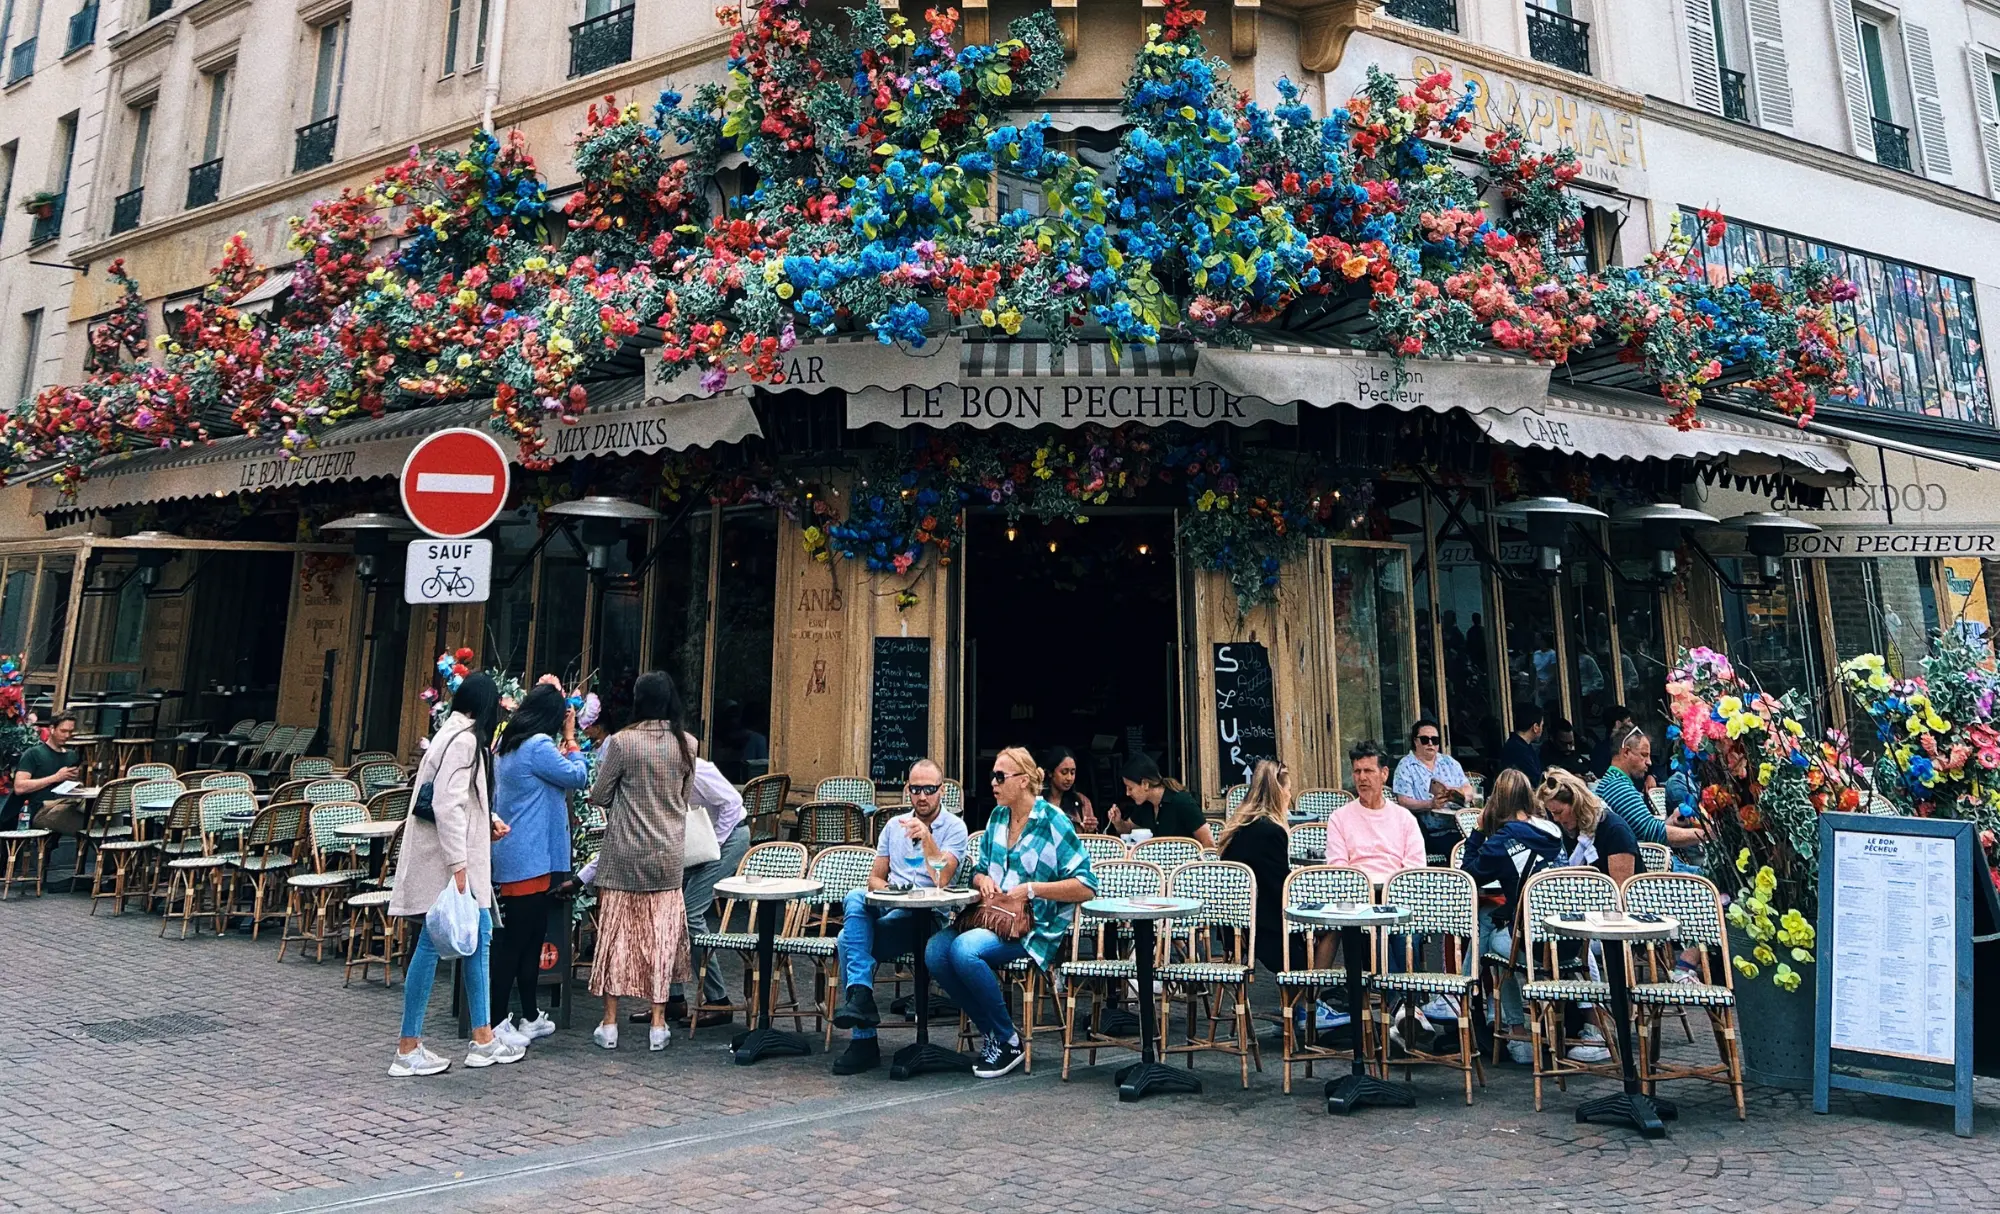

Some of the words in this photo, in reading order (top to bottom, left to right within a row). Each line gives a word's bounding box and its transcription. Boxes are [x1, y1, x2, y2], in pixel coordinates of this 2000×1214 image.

[1584, 163, 1619, 183] UINA
[1370, 366, 1389, 382] Le
[900, 386, 944, 418] LE
[960, 386, 1044, 418] BON
[1061, 386, 1246, 418] PECHEUR
[554, 427, 591, 454] MIX
[592, 418, 668, 450] DRINKS
[1522, 416, 1574, 447] CAFE
[240, 463, 257, 487] LE
[258, 460, 288, 486] BON
[289, 451, 356, 481] PECHEUR
[428, 544, 473, 560] SAUF
[1785, 535, 1844, 553] BON
[1857, 535, 1996, 552] PECHEUR
